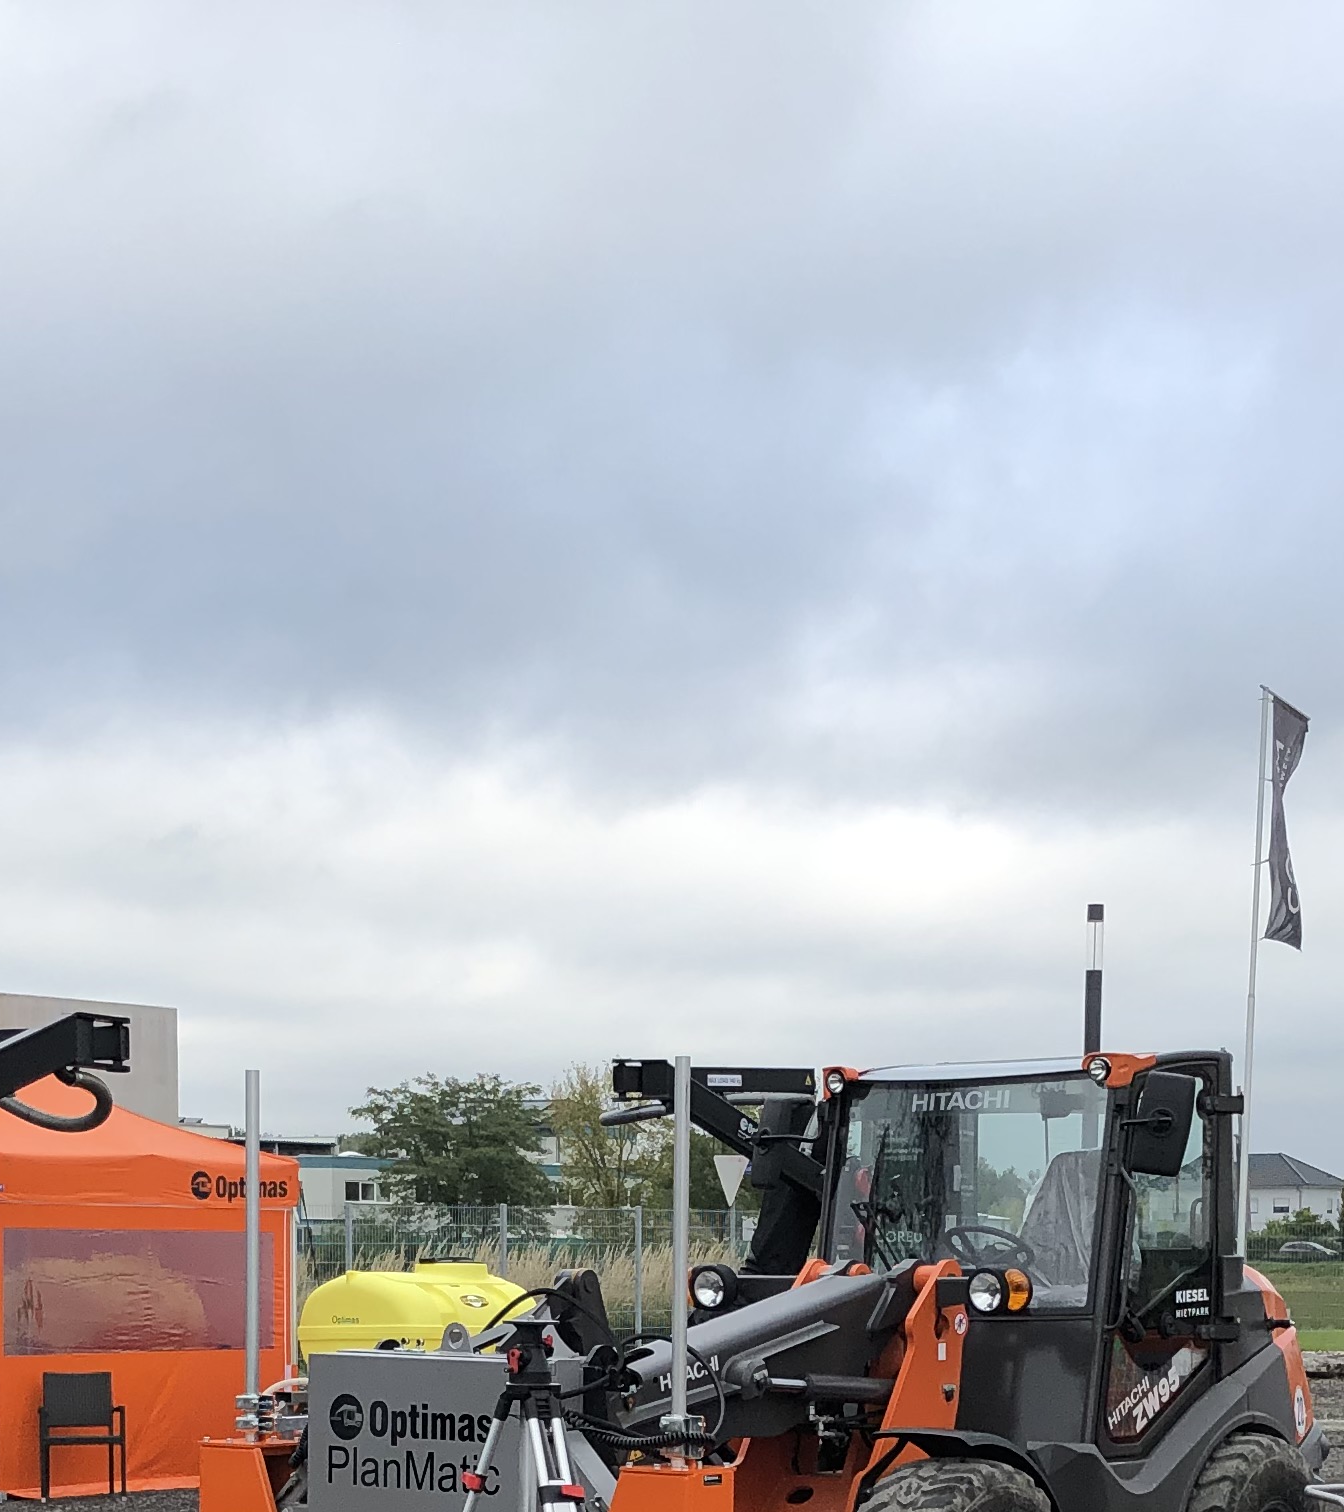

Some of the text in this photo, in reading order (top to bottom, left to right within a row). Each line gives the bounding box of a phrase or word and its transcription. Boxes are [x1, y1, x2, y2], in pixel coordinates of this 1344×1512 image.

[912, 1090, 1010, 1112] HITACHI
[215, 1175, 288, 1203] Optmas
[1175, 1289, 1210, 1304] KIESEL
[659, 1355, 720, 1392] HACHI
[1108, 1375, 1151, 1431] HITACHI
[1132, 1366, 1180, 1434] ZW95
[369, 1400, 493, 1446] Optimas
[327, 1445, 500, 1496] PlanMatc
